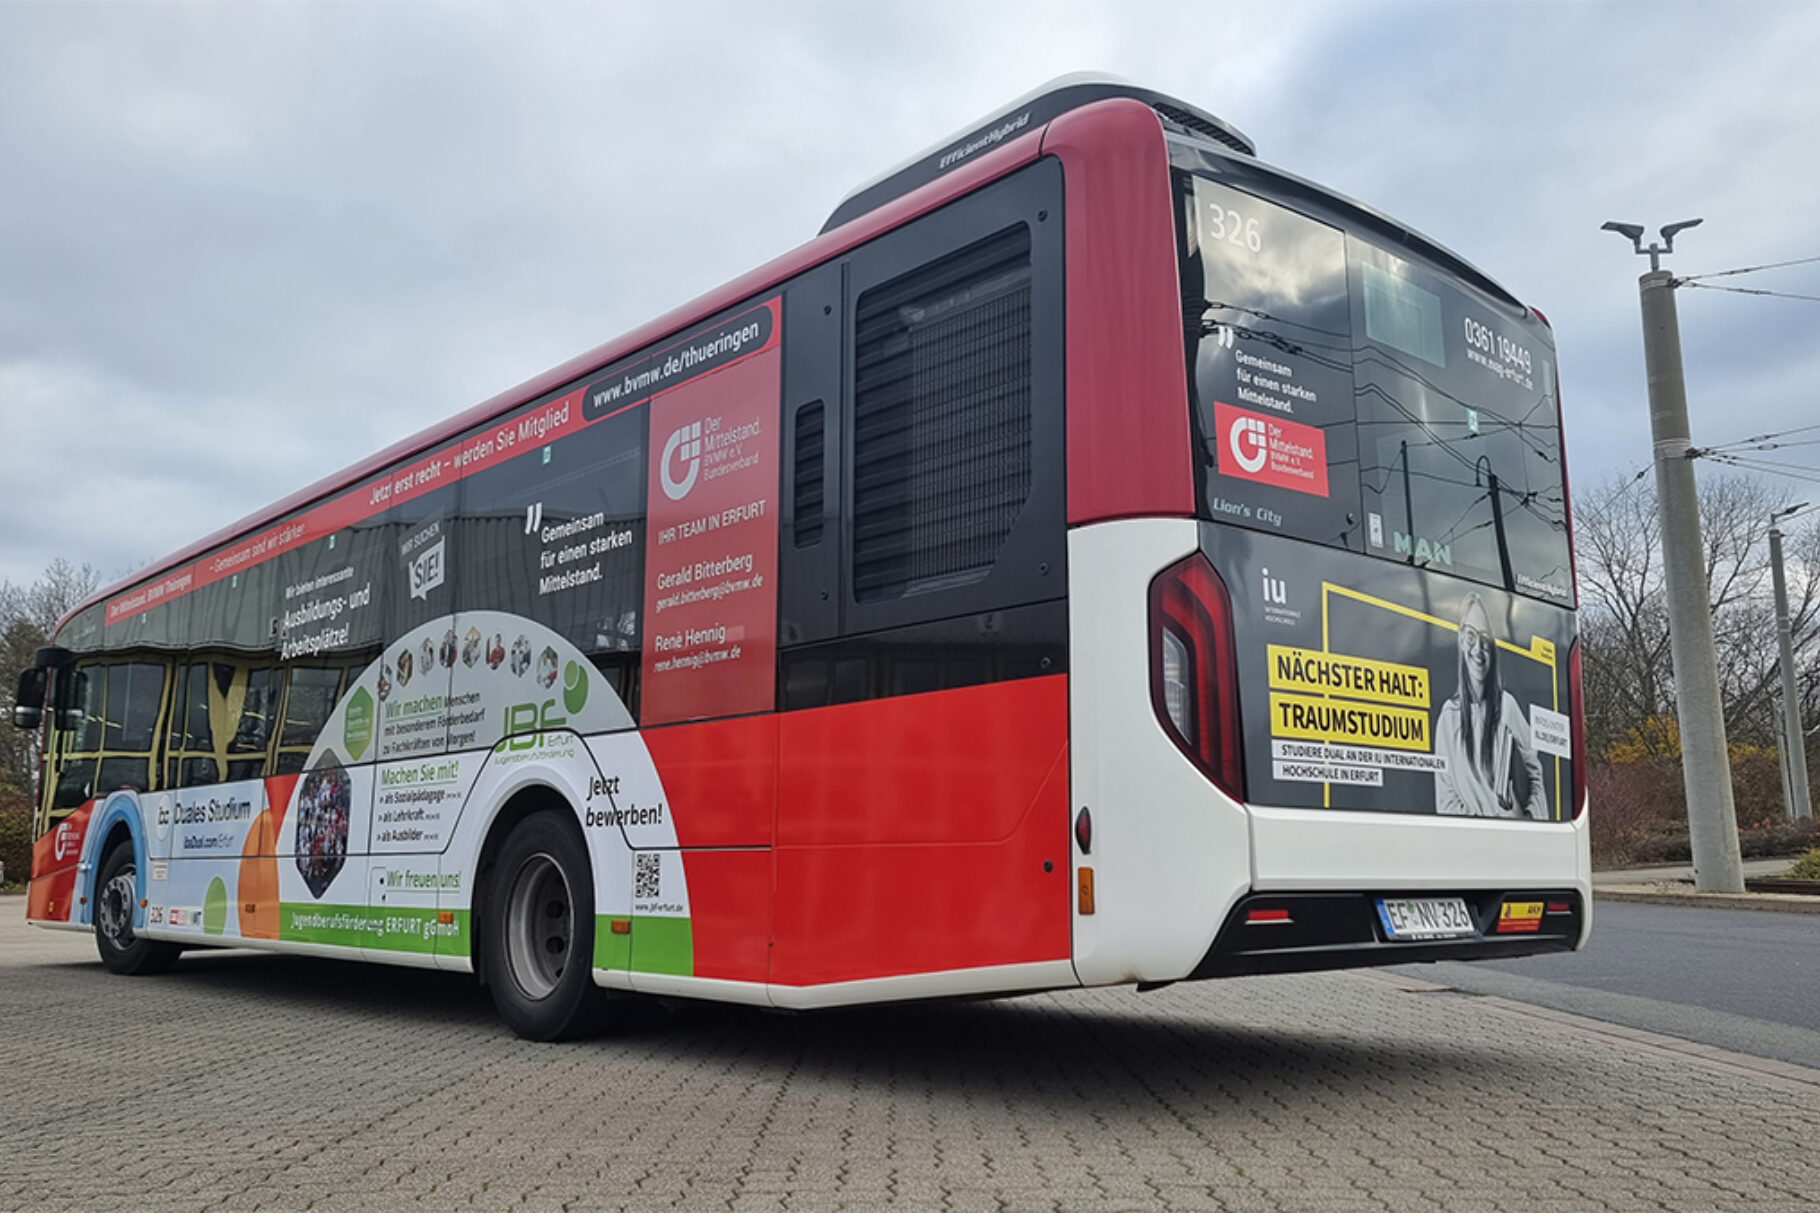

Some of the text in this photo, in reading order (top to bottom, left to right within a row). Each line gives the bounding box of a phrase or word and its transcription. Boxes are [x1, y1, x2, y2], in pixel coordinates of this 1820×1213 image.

[1209, 203, 1261, 253] 326
[1464, 317, 1531, 375] 0361 19449
[593, 321, 759, 408] www.bvmw.de/thueringen
[1235, 349, 1293, 378] Gemeinsam
[1236, 367, 1317, 402] für einen starken
[1237, 386, 1294, 413] Mittelstand.
[703, 415, 722, 435] Der
[704, 416, 762, 452] Mittelstand.
[1268, 423, 1283, 438] Der
[394, 475, 413, 495] erst
[414, 462, 441, 487] recht
[454, 440, 494, 469] werden
[496, 430, 516, 451] Sie
[518, 400, 570, 442] Mitglied
[703, 451, 759, 481] Bundesverband
[658, 499, 767, 545] IHR TEAM IN ERFURT
[1213, 496, 1282, 527] Lion's City
[402, 520, 440, 556] WIR SUCHEN
[541, 512, 604, 543] Gemeinsam
[214, 549, 251, 573] Gemeinsam
[252, 540, 267, 558] sind
[268, 536, 278, 549] wir
[540, 530, 632, 569] für einen starken
[1393, 531, 1452, 566] MAN
[414, 551, 440, 589] SIE!
[539, 561, 603, 595] Mittelstand.
[657, 553, 753, 589] Gerald Bitterberg
[285, 586, 296, 599] Wir
[295, 579, 314, 596] bieten
[1262, 567, 1287, 604] iu
[284, 582, 370, 629] Ausbildungs- und
[280, 622, 349, 661] Arbeitsplätze!
[684, 622, 726, 647] Hennig
[1277, 651, 1424, 699] NÄCHSTER HALT:
[384, 701, 401, 718] Wir
[403, 694, 442, 714] machen
[384, 708, 486, 737] mit besonderem Förderbedarf
[1278, 702, 1424, 742] TRAUMSTUDIUM
[391, 736, 430, 752] Fachkräften
[431, 737, 445, 747] von
[548, 734, 574, 747] Erfurt
[1282, 744, 1446, 770] STUDIERE DUAL AN DER IU INTERNATIONALEN
[381, 760, 459, 785] Machen Sie mit!
[1282, 765, 1379, 782] HOCHSCHULE IN ERFURT
[586, 775, 620, 801] Jetzt
[174, 801, 206, 825] Duales
[208, 797, 251, 823] Studium
[586, 803, 663, 827] bewerben!
[387, 869, 462, 888] Wir freuen uns!
[150, 906, 164, 924] 326
[290, 911, 384, 938] Jugendberufsförderung
[386, 915, 422, 935] ERFURT
[1386, 902, 1408, 930] EF
[1415, 901, 1439, 929] NV
[1438, 901, 1470, 928] 326
